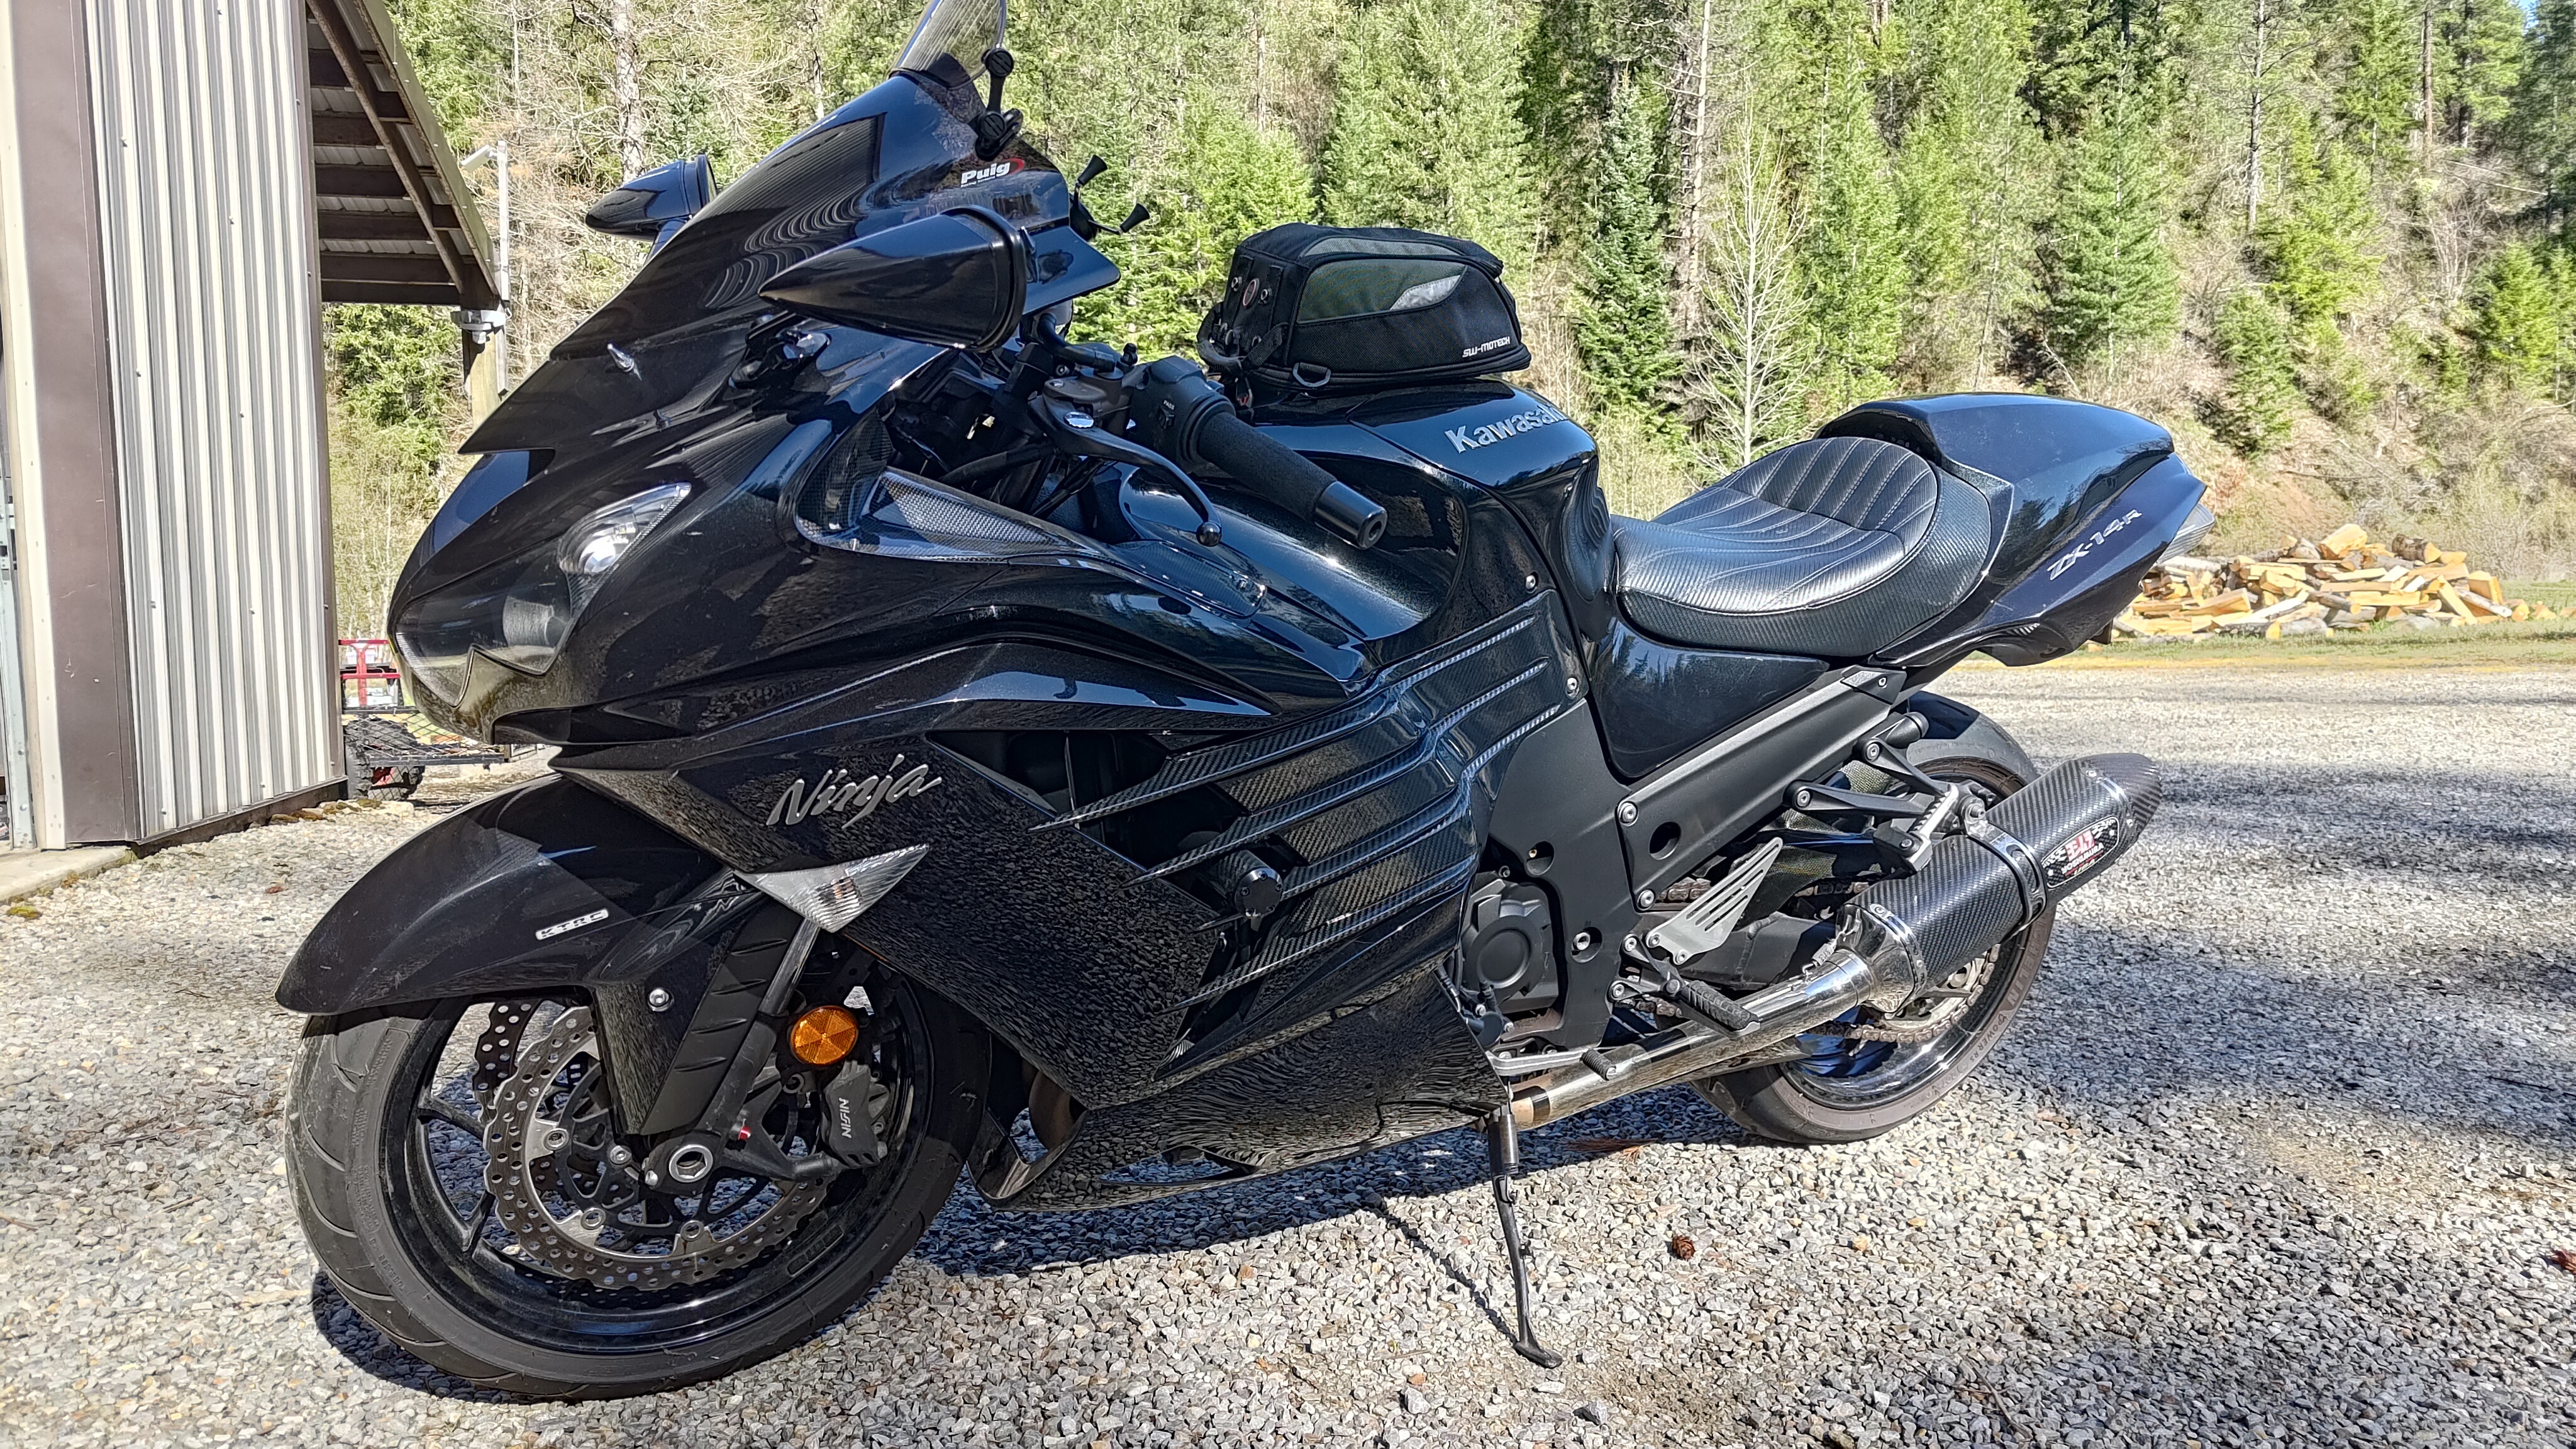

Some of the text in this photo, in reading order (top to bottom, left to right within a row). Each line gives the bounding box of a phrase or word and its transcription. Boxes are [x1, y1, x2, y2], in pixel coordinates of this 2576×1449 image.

[960, 162, 1011, 184] Puig
[1462, 336, 1511, 358] SW-MOTECH
[1445, 404, 1568, 453] Kawasaki
[2047, 509, 2142, 580] ZX-14R
[766, 753, 942, 829] Ninja
[541, 912, 604, 937] KTRC
